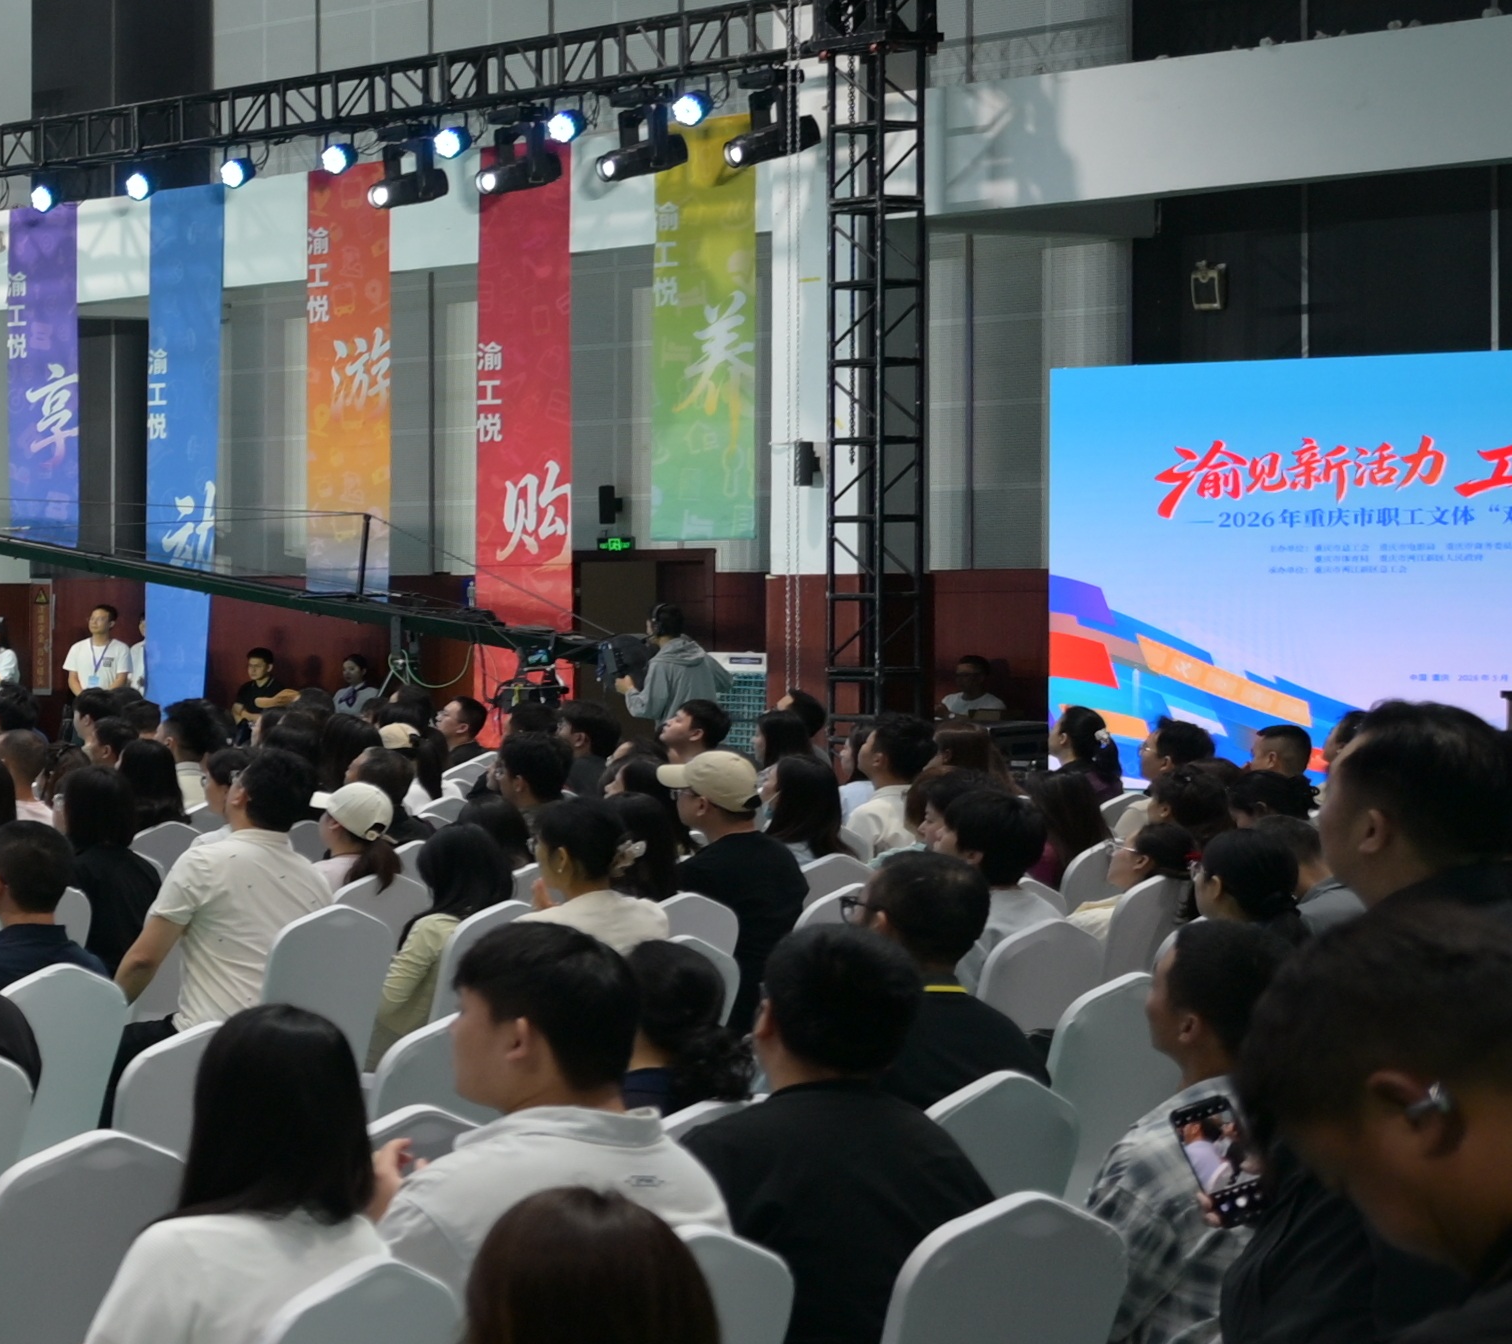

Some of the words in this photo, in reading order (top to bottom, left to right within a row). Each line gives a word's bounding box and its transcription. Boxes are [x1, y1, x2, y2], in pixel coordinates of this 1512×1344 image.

[307, 226, 329, 324] 渝工悦
[25, 363, 79, 469] 享
[331, 327, 391, 422] 游
[476, 342, 502, 443] 渝工悦
[672, 290, 756, 454] 养
[496, 460, 571, 570] 购
[1155, 435, 1447, 519] 渝见新活力
